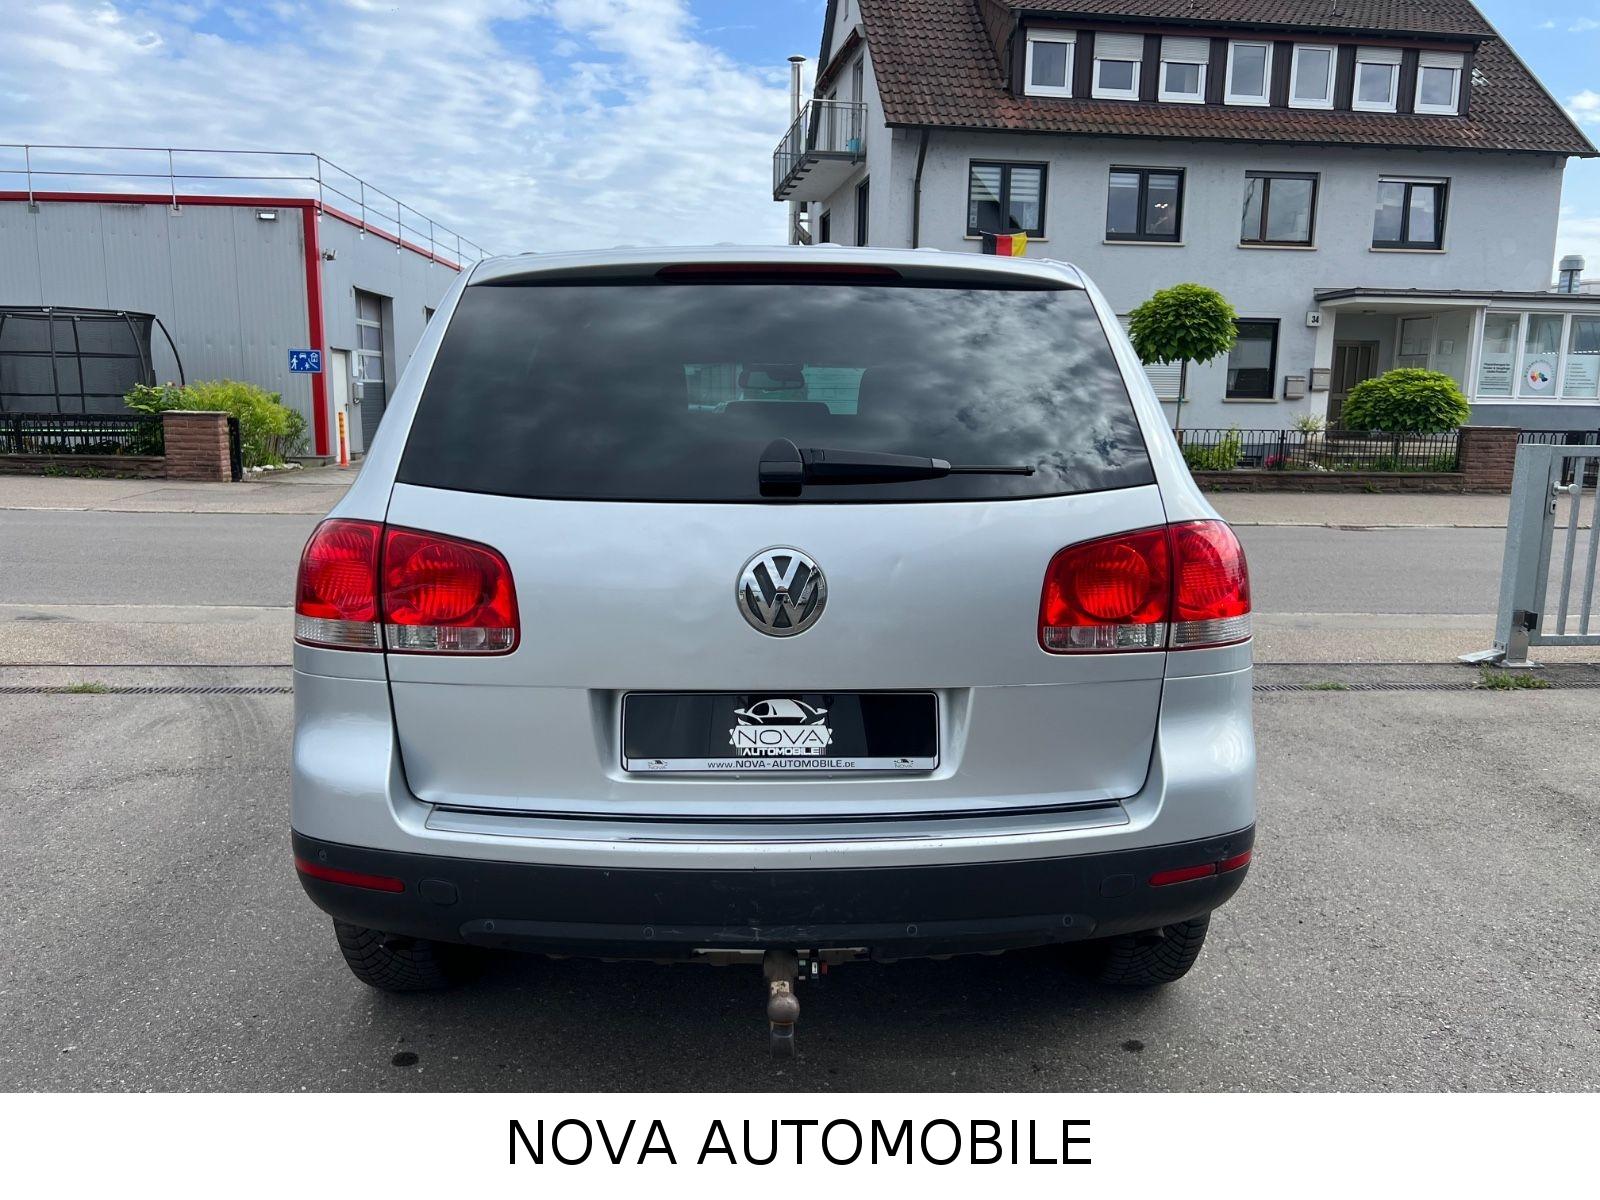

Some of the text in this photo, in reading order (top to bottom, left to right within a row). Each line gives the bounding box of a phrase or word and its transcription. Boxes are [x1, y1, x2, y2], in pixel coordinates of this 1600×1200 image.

[1311, 315, 1320, 324] 34
[738, 546, 827, 638] VW
[738, 729, 824, 745] NOVA
[742, 747, 820, 756] AUTOMOBILE
